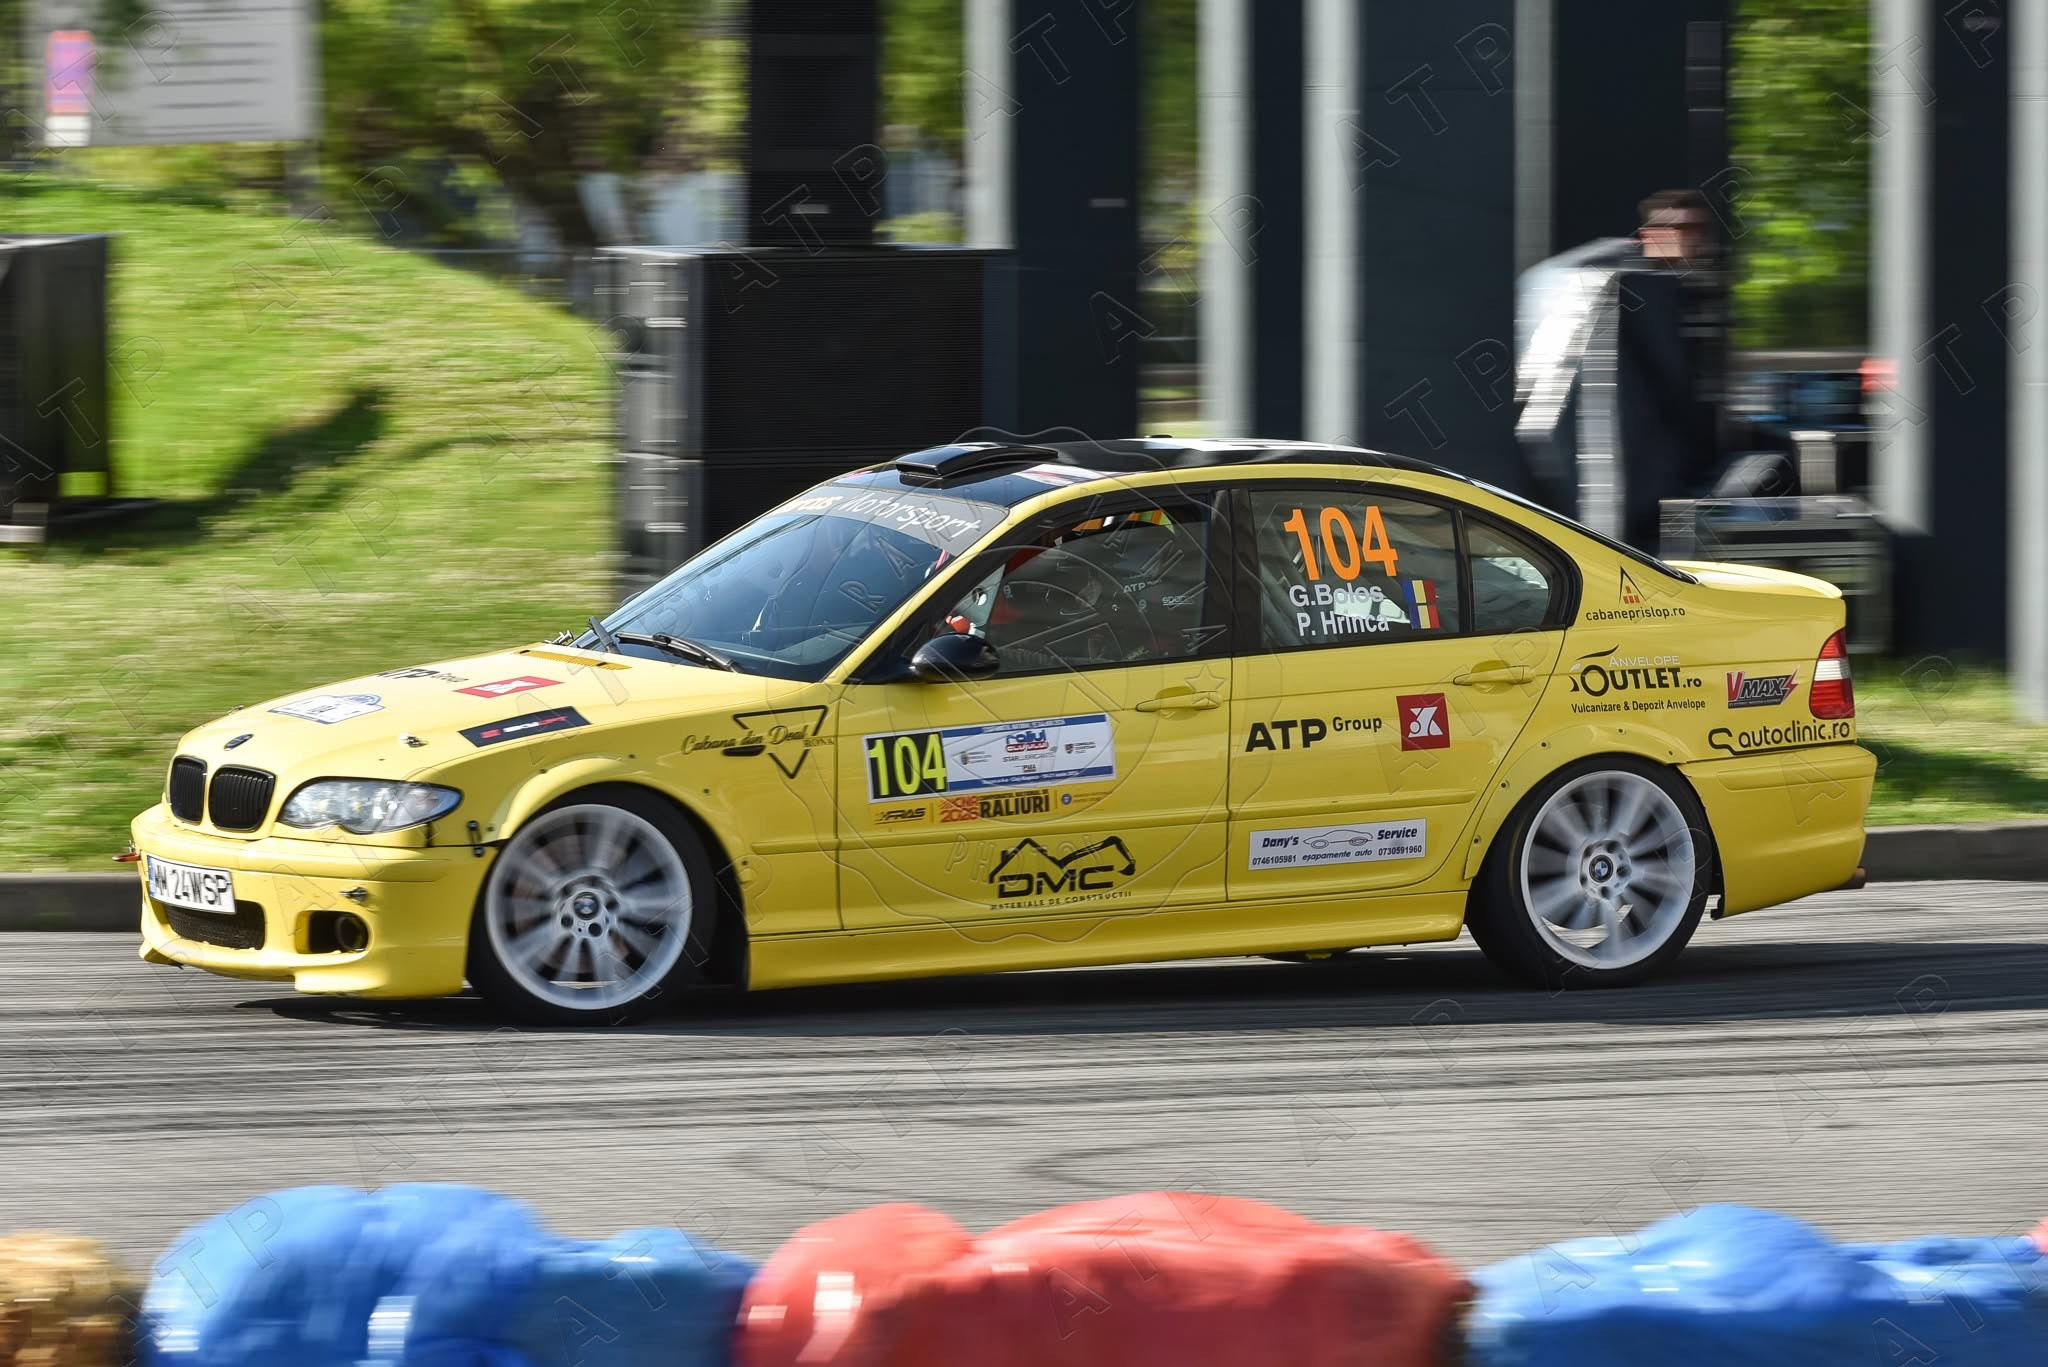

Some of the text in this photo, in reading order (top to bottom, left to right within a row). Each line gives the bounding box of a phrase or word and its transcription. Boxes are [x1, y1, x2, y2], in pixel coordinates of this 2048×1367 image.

[837, 492, 981, 538] Motorsport
[1283, 505, 1398, 581] 104
[1296, 612, 1316, 637] P.
[1585, 606, 1686, 621] cabaneprislop.ro
[1726, 671, 1785, 702] VMAX
[1571, 698, 1706, 713] Vulcanizare & Depozit Anvelope
[1245, 716, 1382, 752] ATP Group
[1738, 719, 1850, 748] autoclinic.ro
[868, 733, 946, 796] 104
[980, 794, 1050, 818] RALIURI
[1262, 826, 1417, 848] Dany's Service
[1252, 855, 1297, 866] 0746105981
[1355, 848, 1372, 857] auto
[1378, 845, 1422, 856] 0730591960
[998, 865, 1114, 898] DMC
